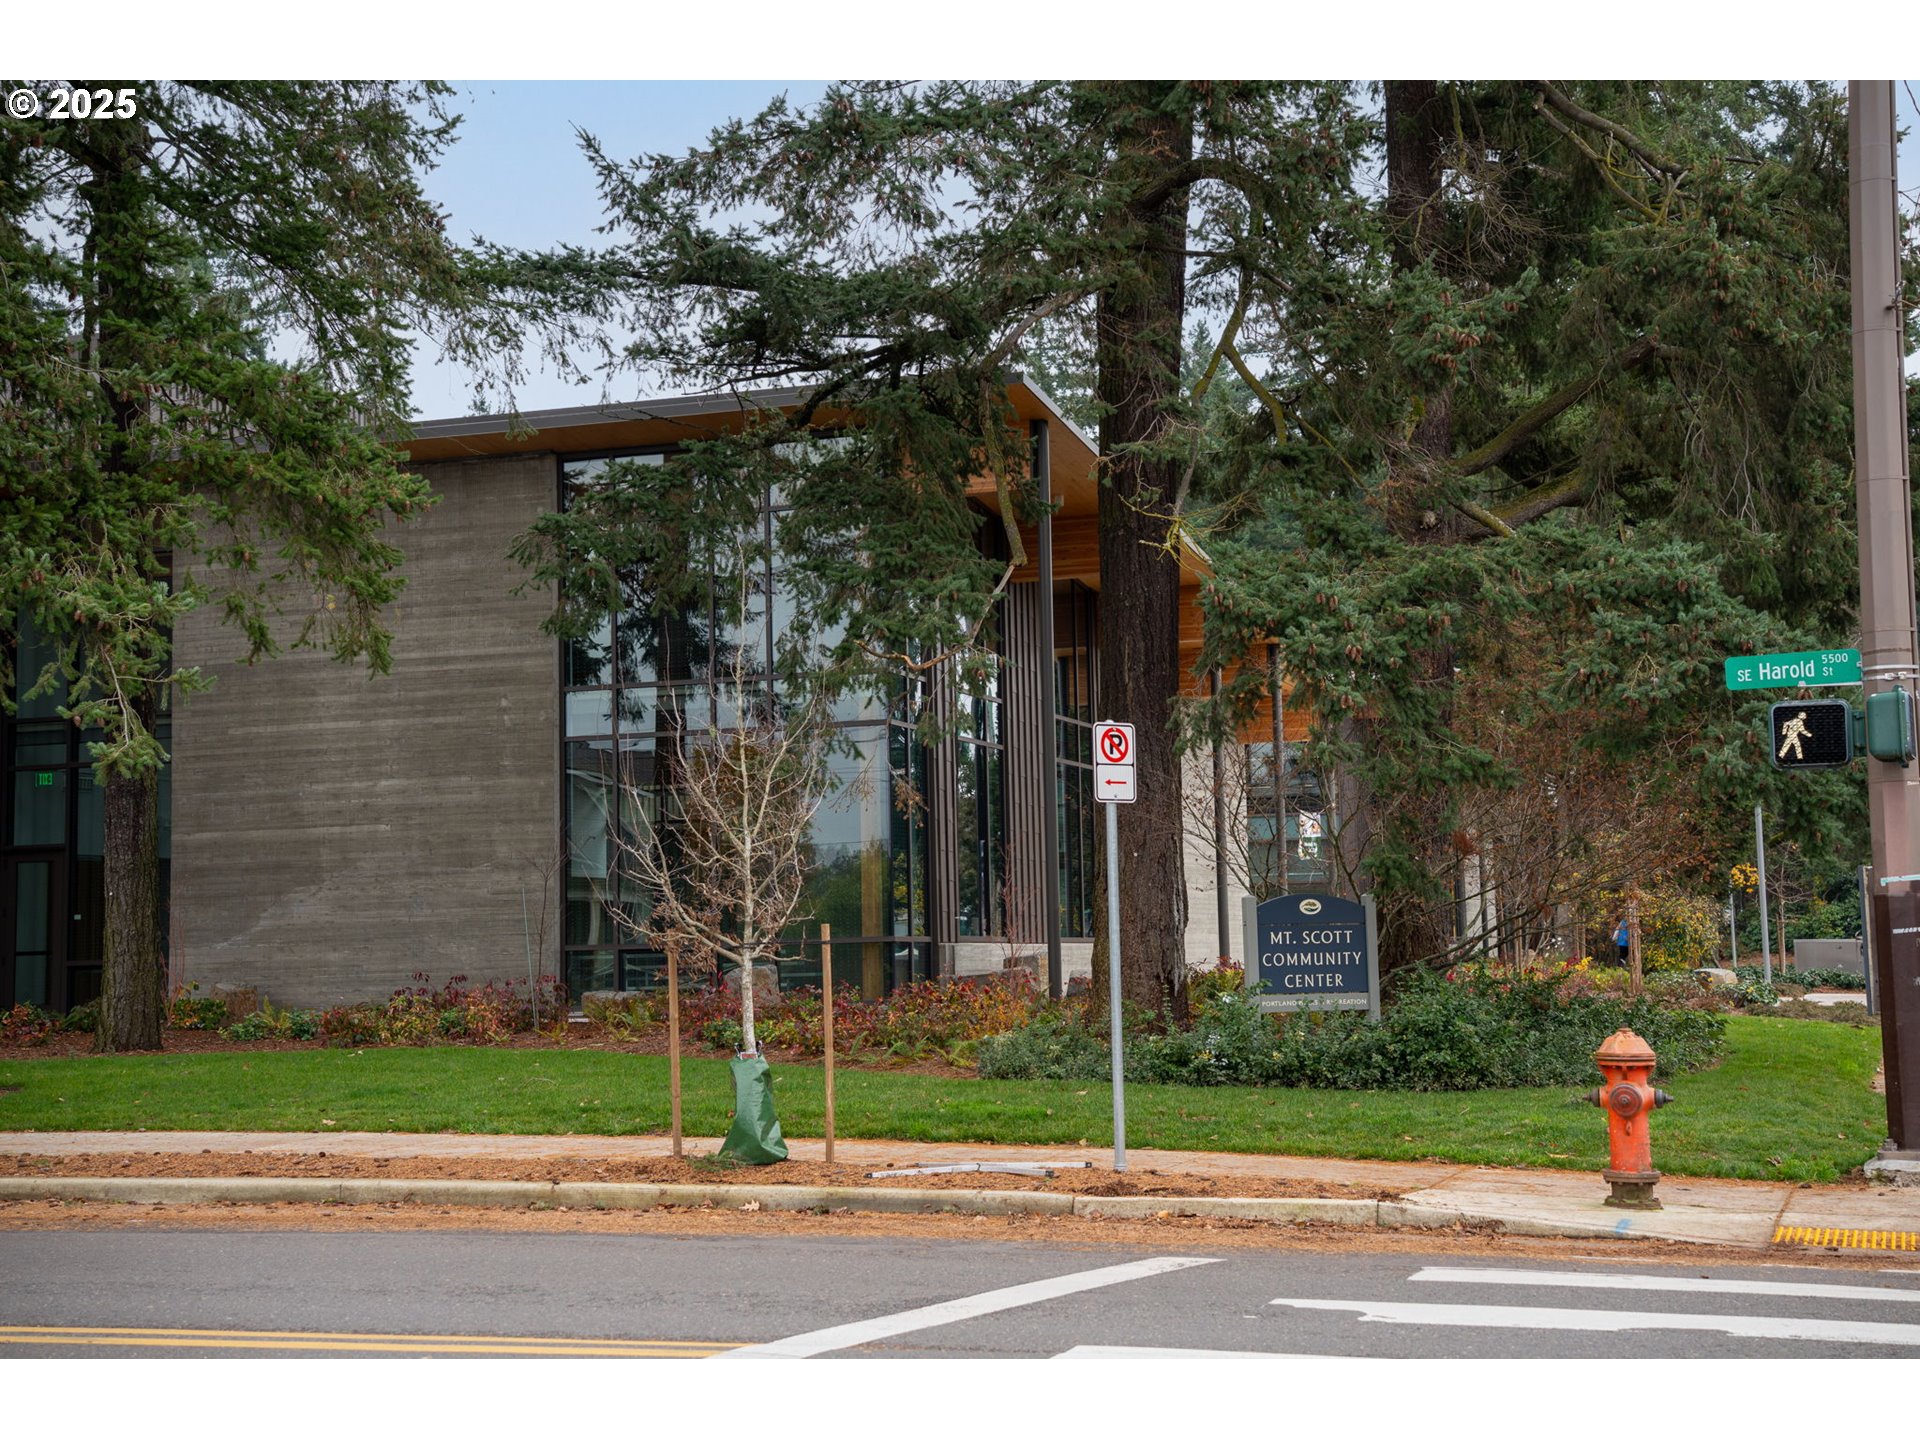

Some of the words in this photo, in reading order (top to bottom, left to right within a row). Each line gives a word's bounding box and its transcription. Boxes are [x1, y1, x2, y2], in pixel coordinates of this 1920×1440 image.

[1821, 653, 1849, 664] 5500
[1737, 669, 1752, 682] SE
[1759, 660, 1815, 681] Harold
[1822, 666, 1834, 677] St
[1109, 734, 1123, 755] P
[1270, 931, 1297, 945] MT.
[1302, 930, 1353, 945] SCOTT
[1262, 951, 1362, 967] COMMUNITY
[1284, 973, 1344, 988] CENTER
